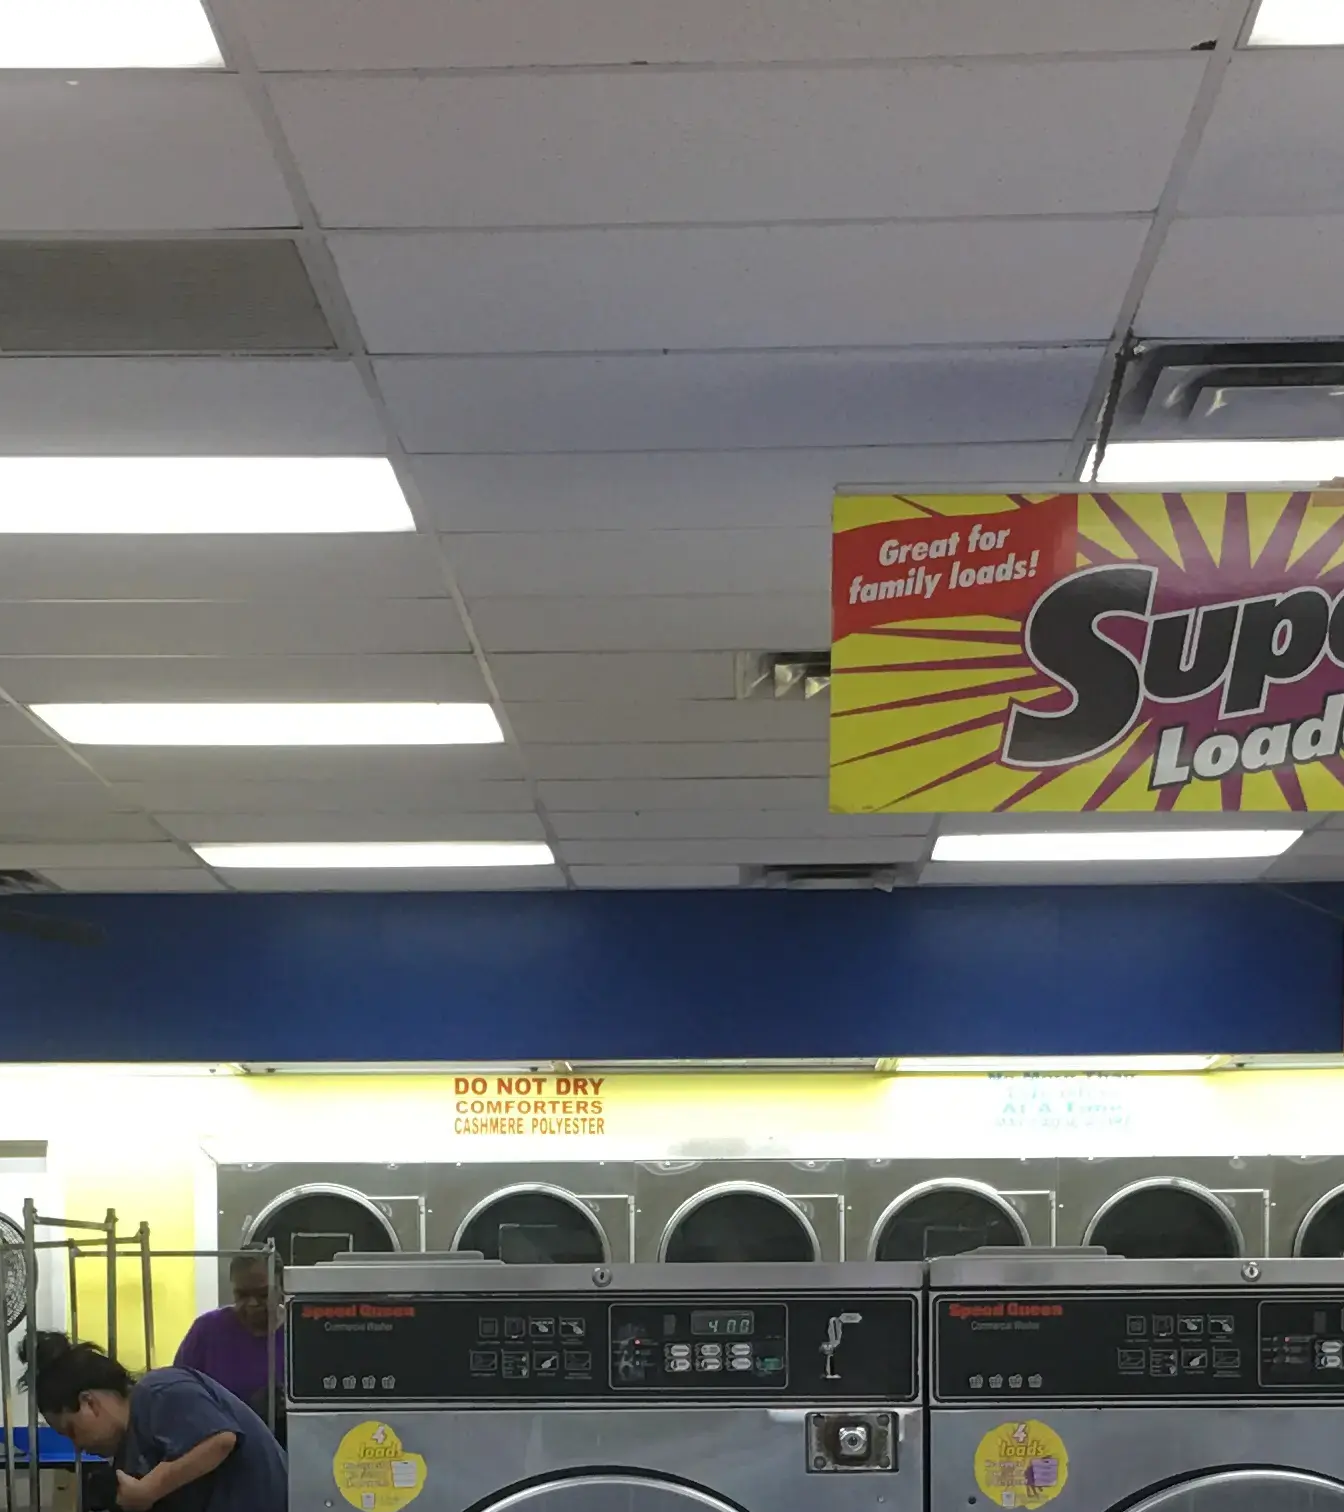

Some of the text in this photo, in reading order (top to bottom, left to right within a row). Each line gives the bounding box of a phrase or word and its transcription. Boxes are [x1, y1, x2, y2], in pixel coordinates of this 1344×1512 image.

[879, 524, 1010, 566] Great for
[849, 550, 1039, 604] family loads!
[455, 1078, 605, 1096] DO NOT DRY
[455, 1101, 603, 1115] COMFORTERS
[454, 1117, 605, 1135] CASHMERE POLYESTER
[1013, 1423, 1027, 1443] 4
[1000, 1440, 1044, 1457] loads
